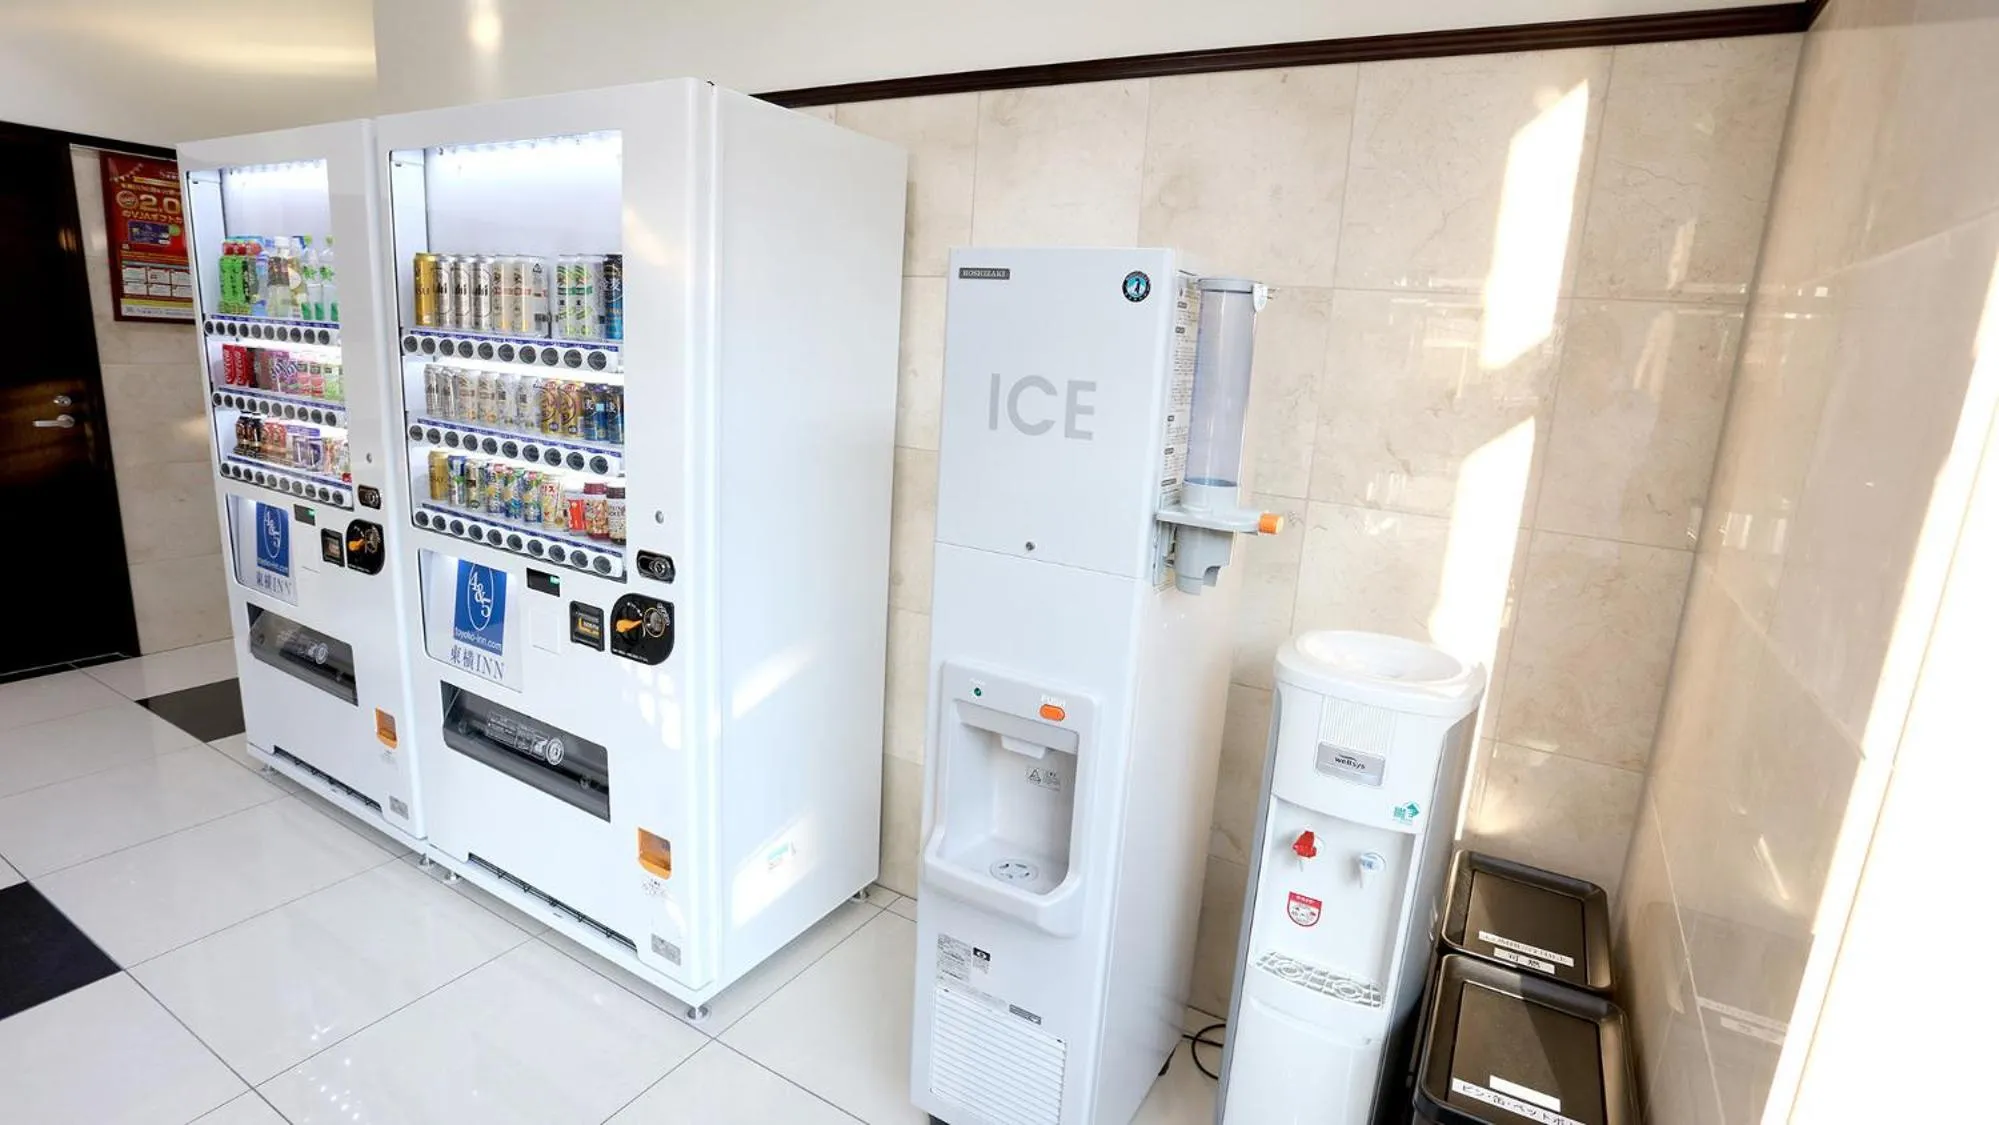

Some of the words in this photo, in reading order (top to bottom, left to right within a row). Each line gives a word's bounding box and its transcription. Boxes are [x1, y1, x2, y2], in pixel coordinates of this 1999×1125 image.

[962, 269, 1006, 278] HOSHIZAKI
[988, 373, 1097, 441] ICE
[454, 626, 502, 650] toyoko-inn.com
[451, 644, 505, 680] 東横INN
[1334, 757, 1366, 770] wellsys
